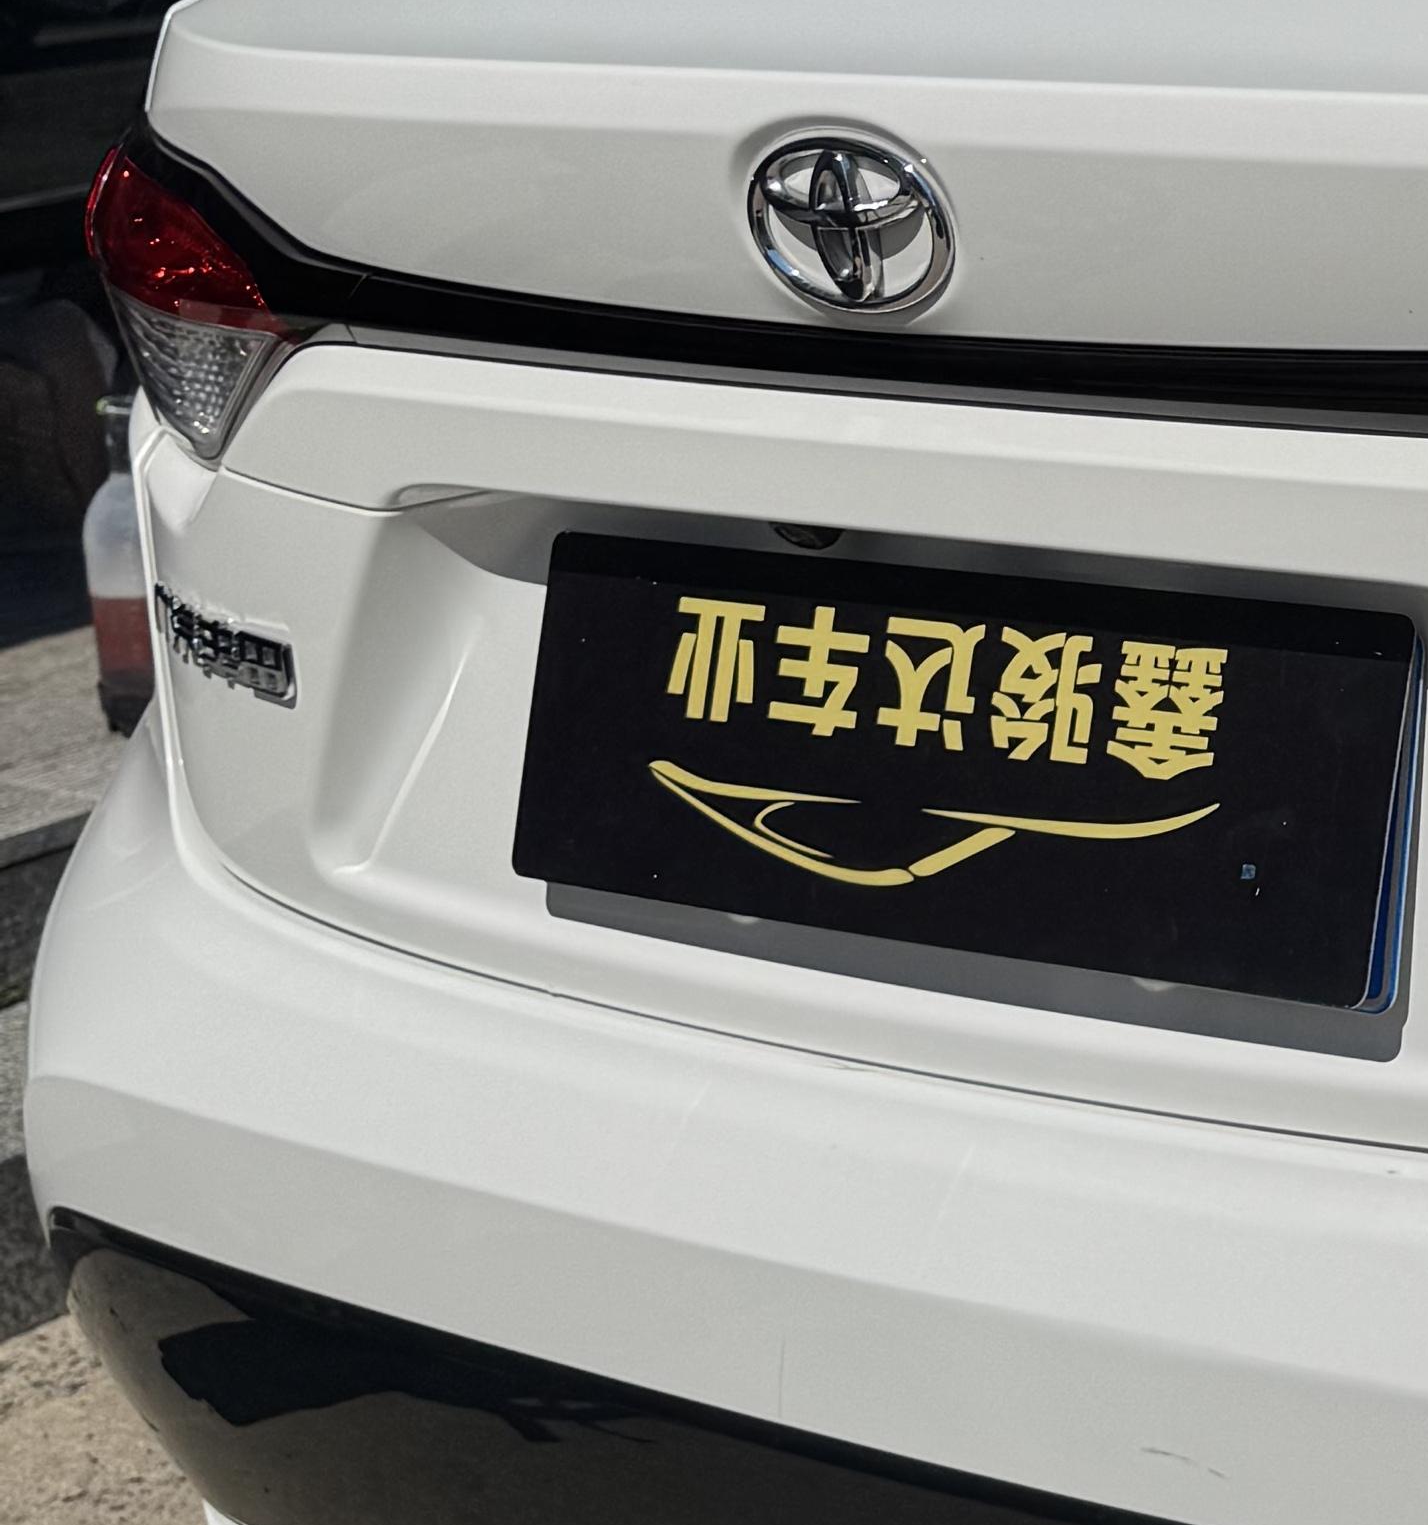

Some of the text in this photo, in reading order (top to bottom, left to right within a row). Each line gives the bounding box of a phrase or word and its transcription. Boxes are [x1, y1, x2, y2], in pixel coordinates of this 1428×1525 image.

[666, 597, 1228, 782] 鑫骏达车业
